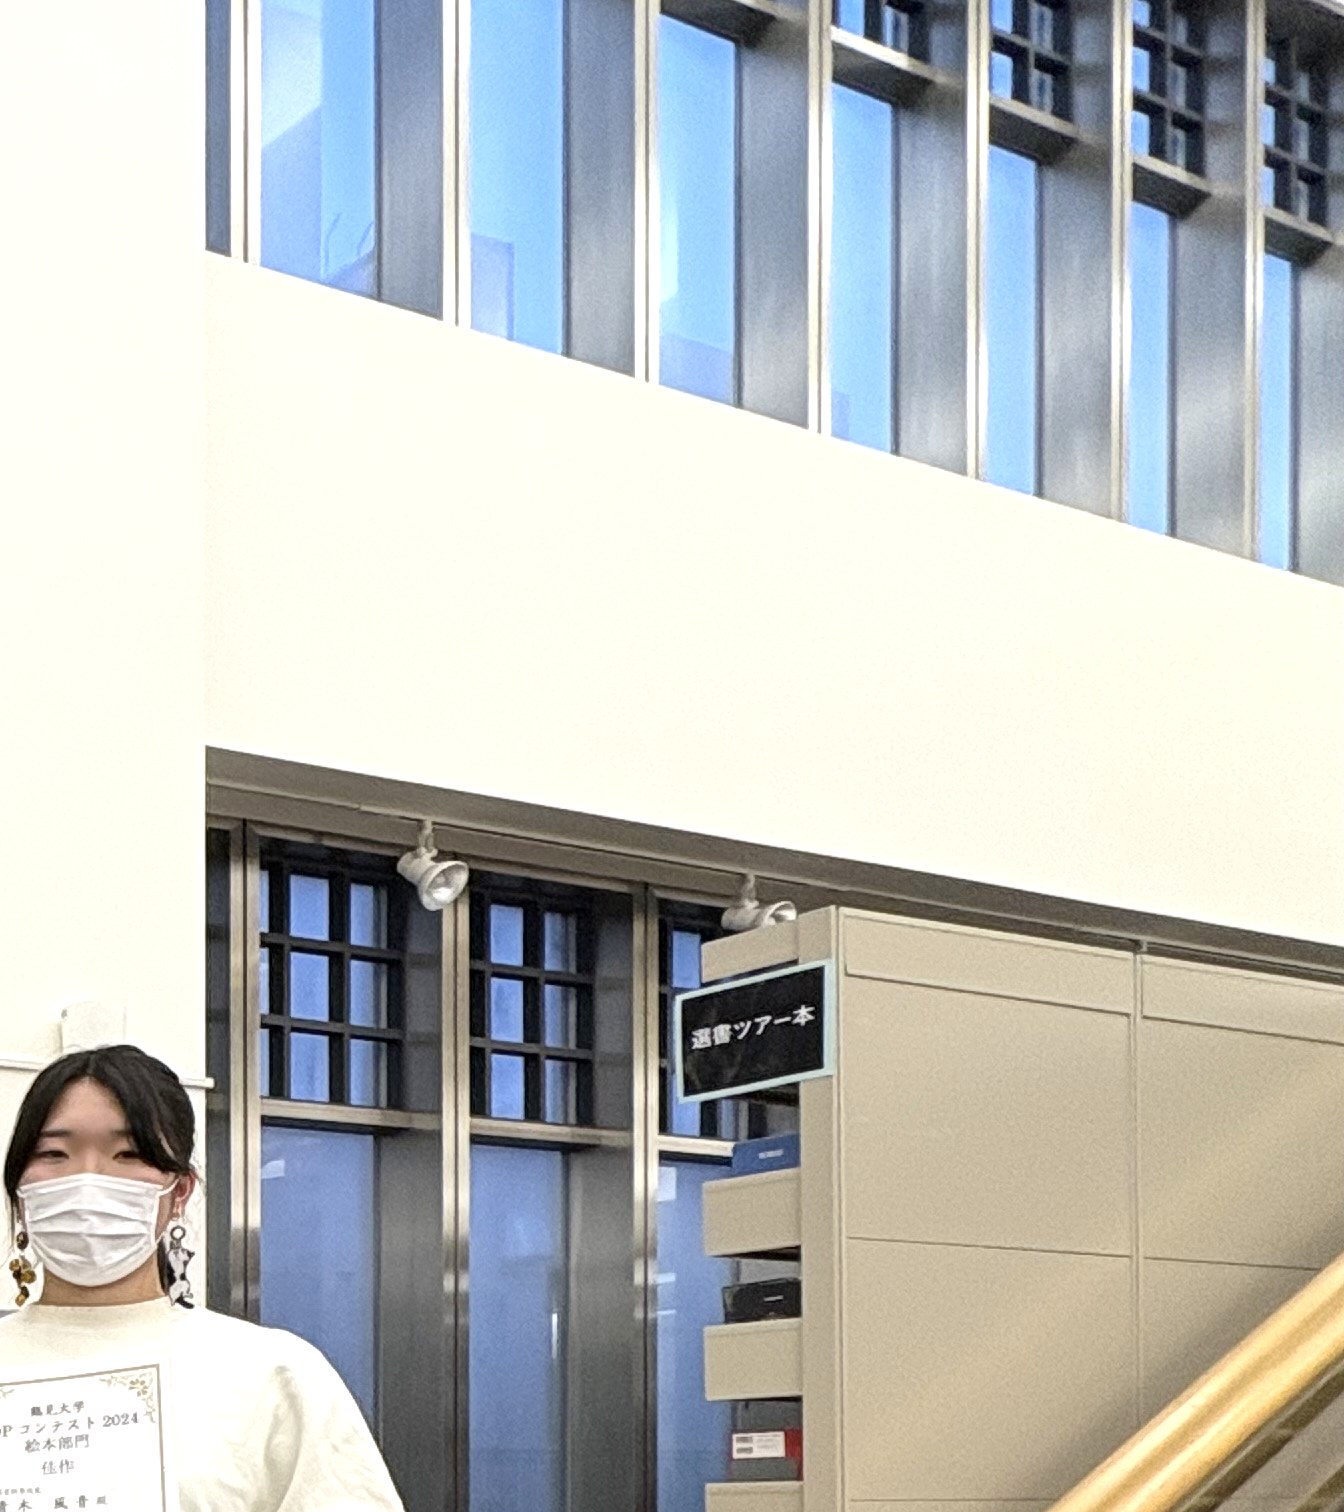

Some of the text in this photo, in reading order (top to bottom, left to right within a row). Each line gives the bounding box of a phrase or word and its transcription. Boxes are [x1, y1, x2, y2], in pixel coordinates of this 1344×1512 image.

[691, 1004, 816, 1050] 選書ツアー本
[19, 1416, 95, 1435] コンテスト
[102, 1412, 139, 1428] 2024
[41, 1459, 75, 1476] 佳作
